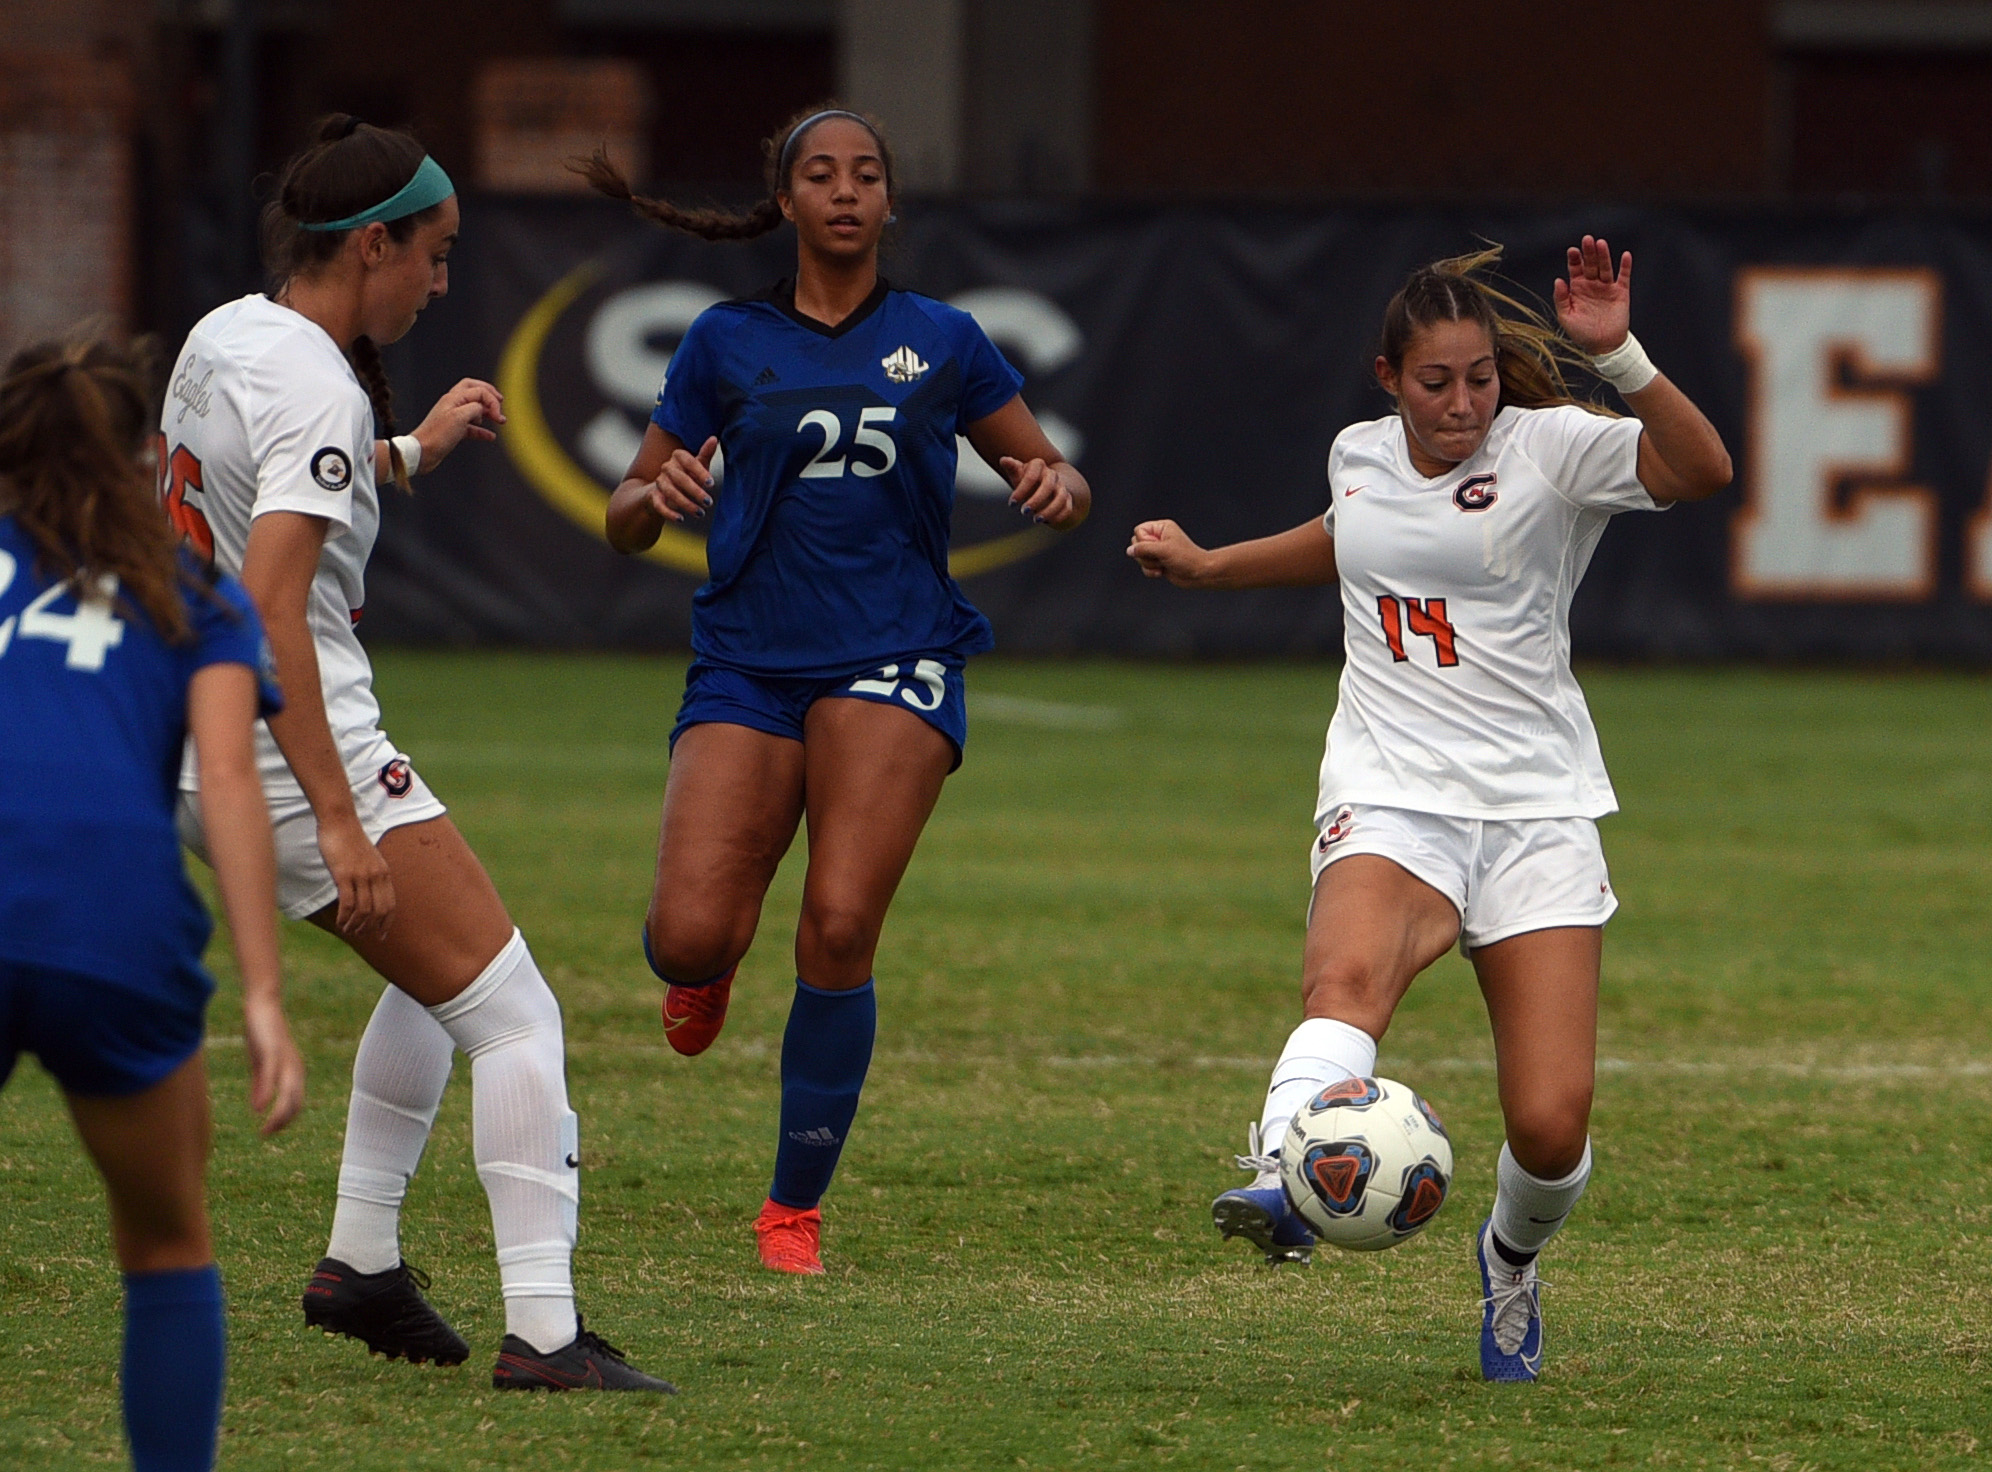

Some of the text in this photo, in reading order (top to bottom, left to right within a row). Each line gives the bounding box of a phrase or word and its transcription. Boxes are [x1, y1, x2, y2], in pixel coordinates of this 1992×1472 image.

[173, 353, 214, 424] Eagles
[796, 407, 897, 478] 25
[1730, 268, 1992, 600] E
[1376, 594, 1460, 668] 14
[849, 658, 947, 711] 25
